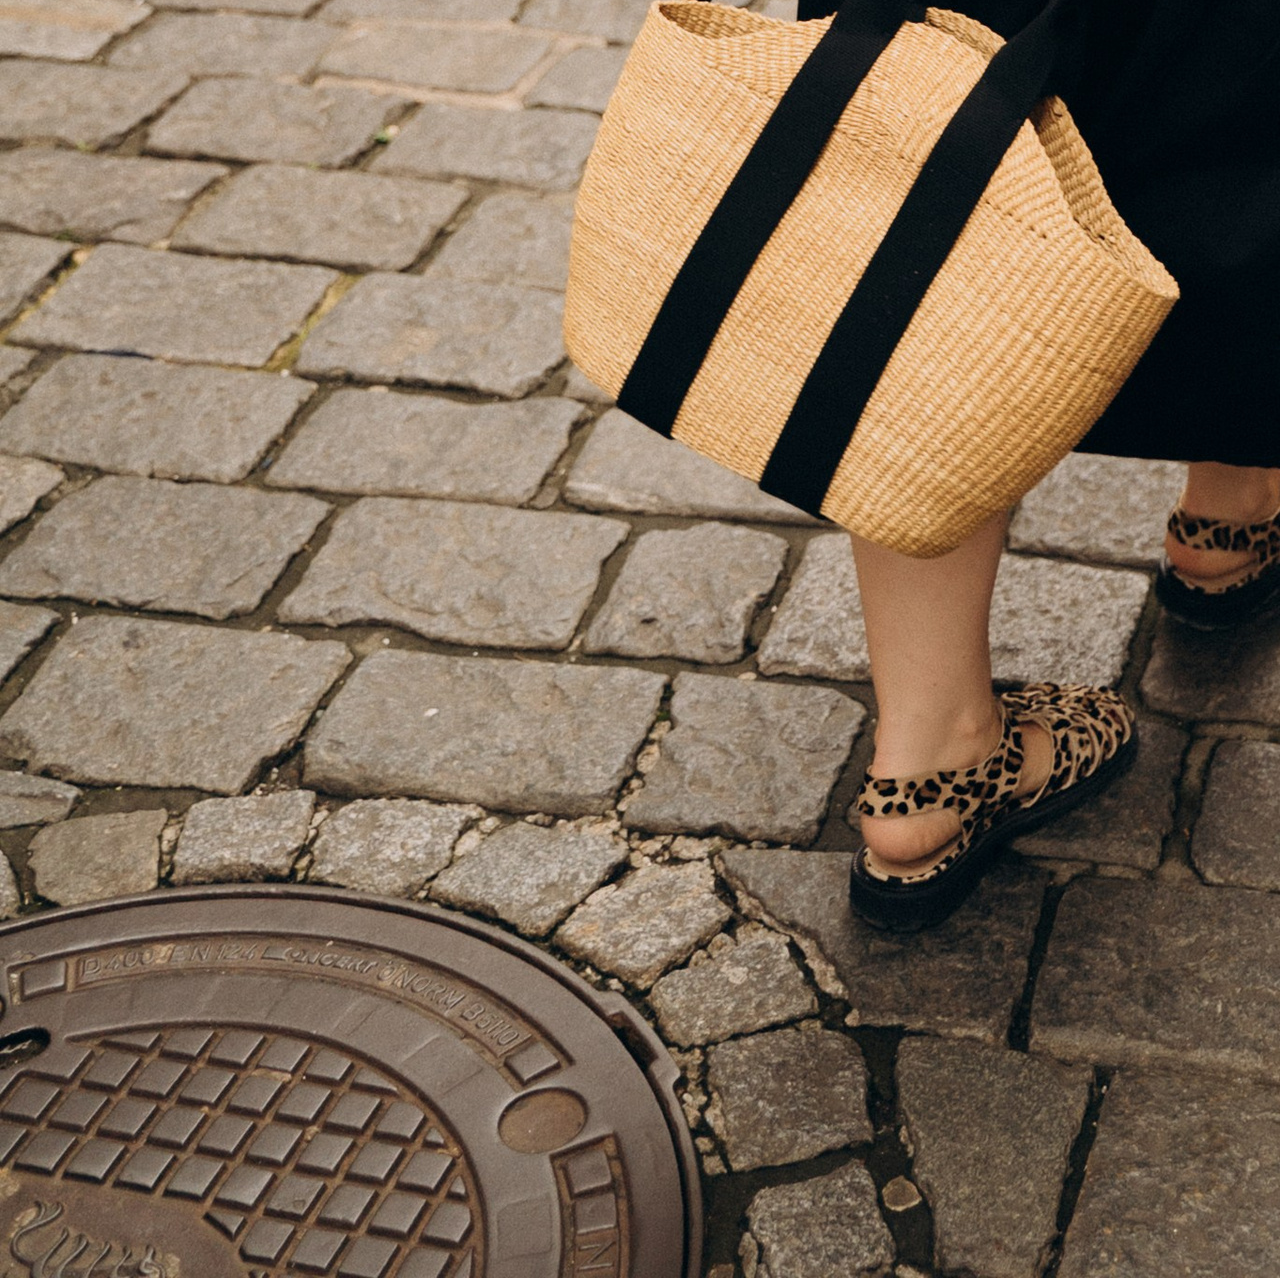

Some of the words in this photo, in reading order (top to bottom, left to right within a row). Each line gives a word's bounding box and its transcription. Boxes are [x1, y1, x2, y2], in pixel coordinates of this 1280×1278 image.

[81, 956, 101, 977] D
[106, 951, 154, 971] 400
[216, 943, 258, 961] 124
[376, 960, 467, 1011] ÖNORM
[460, 1002, 521, 1047] B5110
